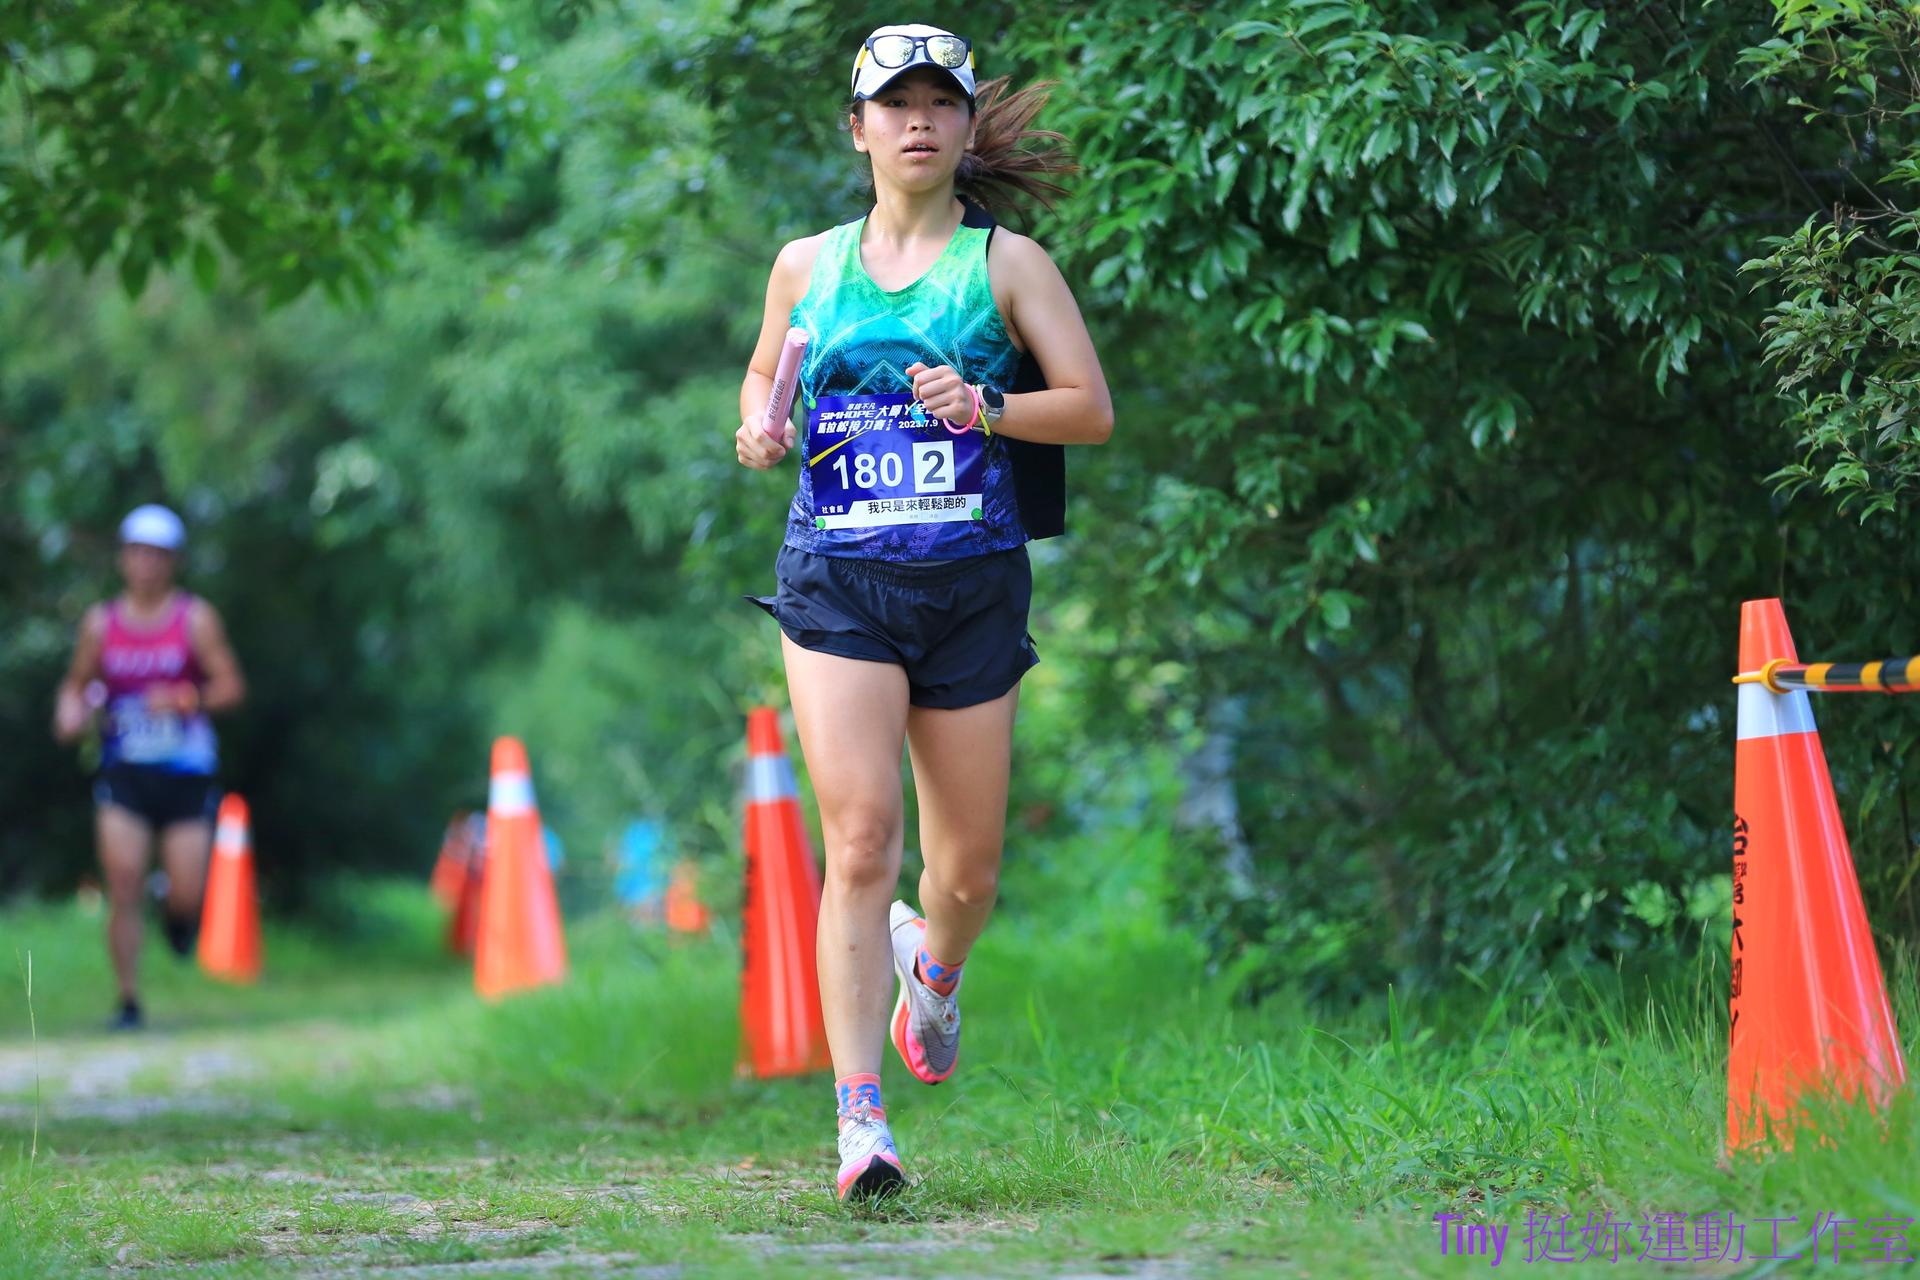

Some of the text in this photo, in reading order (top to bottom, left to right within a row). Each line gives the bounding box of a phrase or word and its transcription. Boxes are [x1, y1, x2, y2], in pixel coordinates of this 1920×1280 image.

[819, 409, 878, 421] SIMHOPE
[832, 450, 947, 490] 180 2
[867, 496, 967, 515] 我只是來輕鬆跑的
